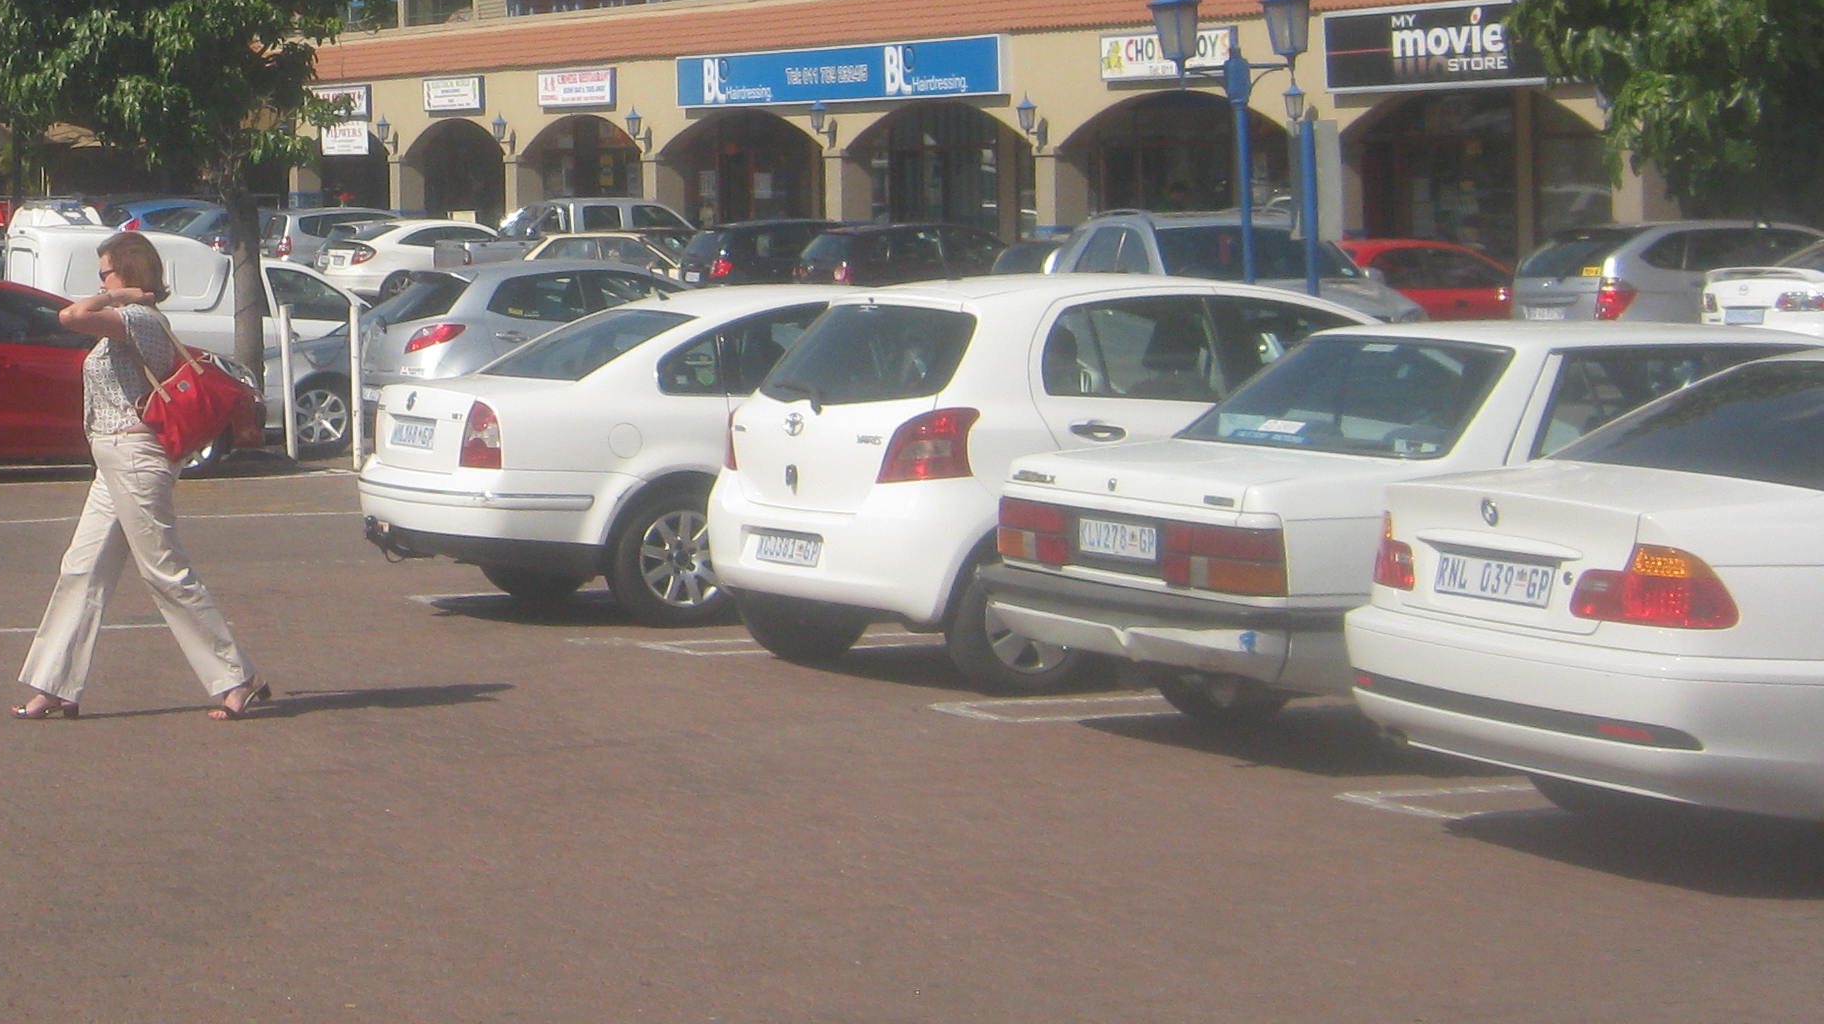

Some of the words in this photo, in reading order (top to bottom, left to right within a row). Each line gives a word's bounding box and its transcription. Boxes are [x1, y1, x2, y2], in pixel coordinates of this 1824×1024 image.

[1391, 14, 1417, 28] MY
[1391, 7, 1505, 58] movie
[1196, 32, 1230, 58] OYS
[1447, 55, 1509, 72] STORE
[1139, 527, 1155, 553] GP
[1437, 557, 1467, 589] RNL
[1480, 562, 1514, 595] 039
[1526, 568, 1550, 600] GP
